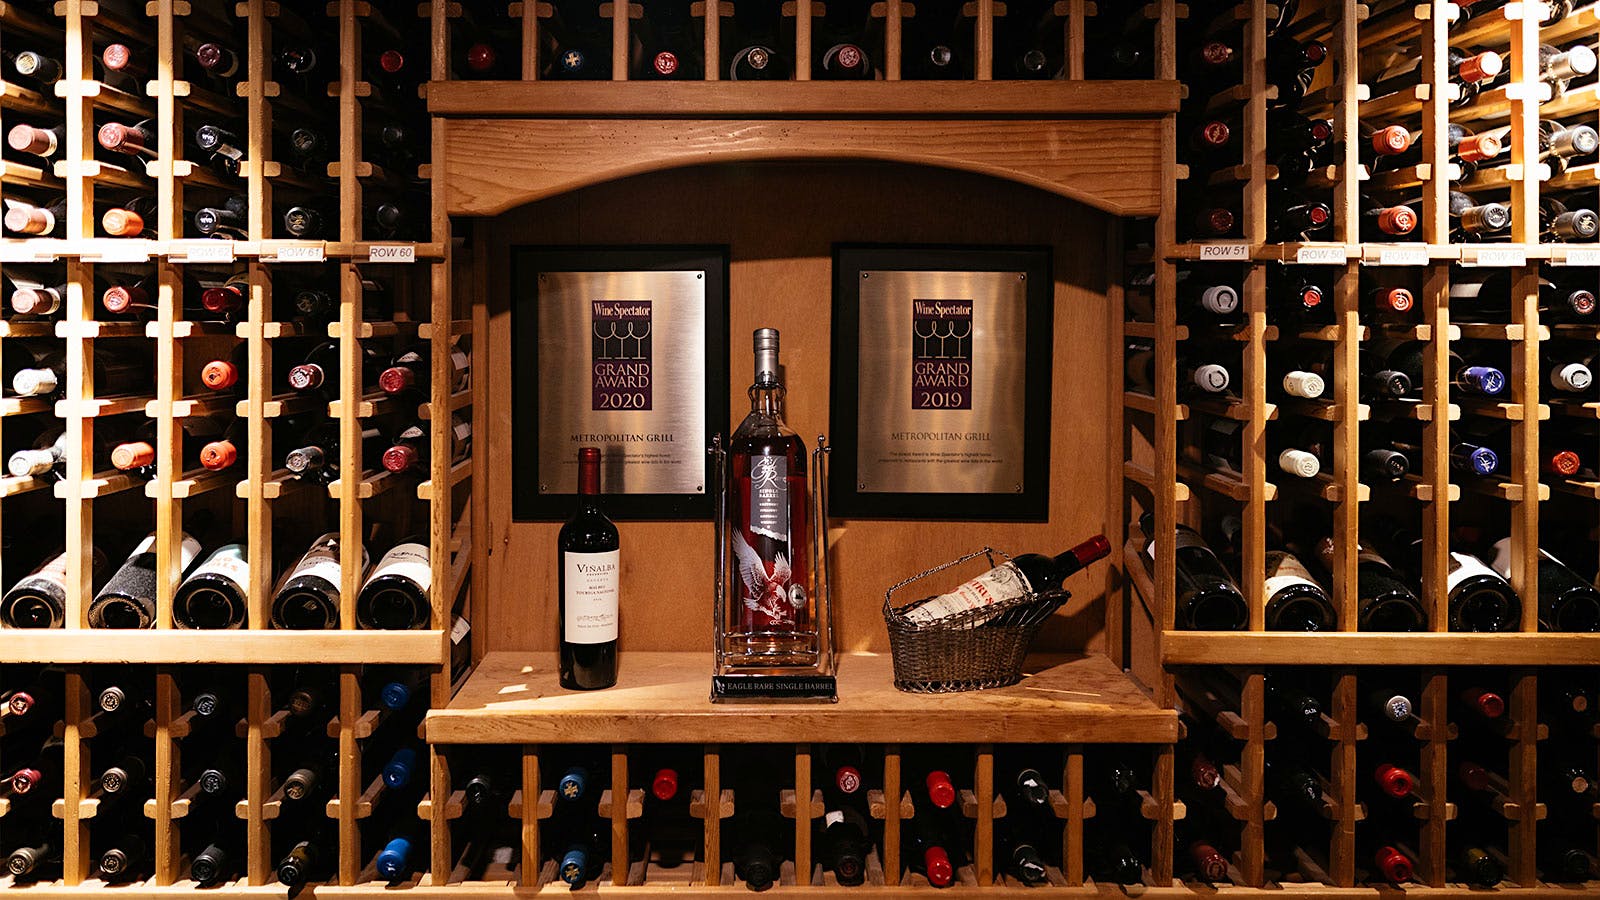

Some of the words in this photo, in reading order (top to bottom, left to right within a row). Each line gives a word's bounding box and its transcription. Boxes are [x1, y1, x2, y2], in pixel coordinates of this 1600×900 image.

[278, 247, 306, 257] ROW
[307, 247, 321, 257] 61
[370, 247, 399, 257] ROW
[399, 247, 412, 257] 60
[1204, 246, 1232, 256] ROW
[1233, 246, 1246, 256] 51
[1301, 249, 1329, 259] ROW
[1329, 249, 1343, 259] 50
[1480, 251, 1509, 260] ROW
[594, 302, 614, 316] Wine
[614, 302, 651, 319] Spectator
[915, 301, 934, 315] Wine
[935, 301, 972, 319] Spectator
[594, 363, 650, 376] GRAND
[914, 362, 970, 375] GRAND
[595, 375, 650, 388] AWARD
[914, 374, 969, 387] AWARD
[600, 392, 646, 409] 2020
[920, 391, 962, 408] 2019
[570, 433, 644, 443] METROPOLITAN
[646, 433, 675, 443] GRILL
[891, 431, 963, 441] METROPOLITAN
[965, 431, 992, 441] GRILL
[727, 682, 753, 690] EAGLE
[754, 682, 774, 690] RARE
[775, 682, 804, 690] SINGLE
[804, 682, 834, 690] BARREL
